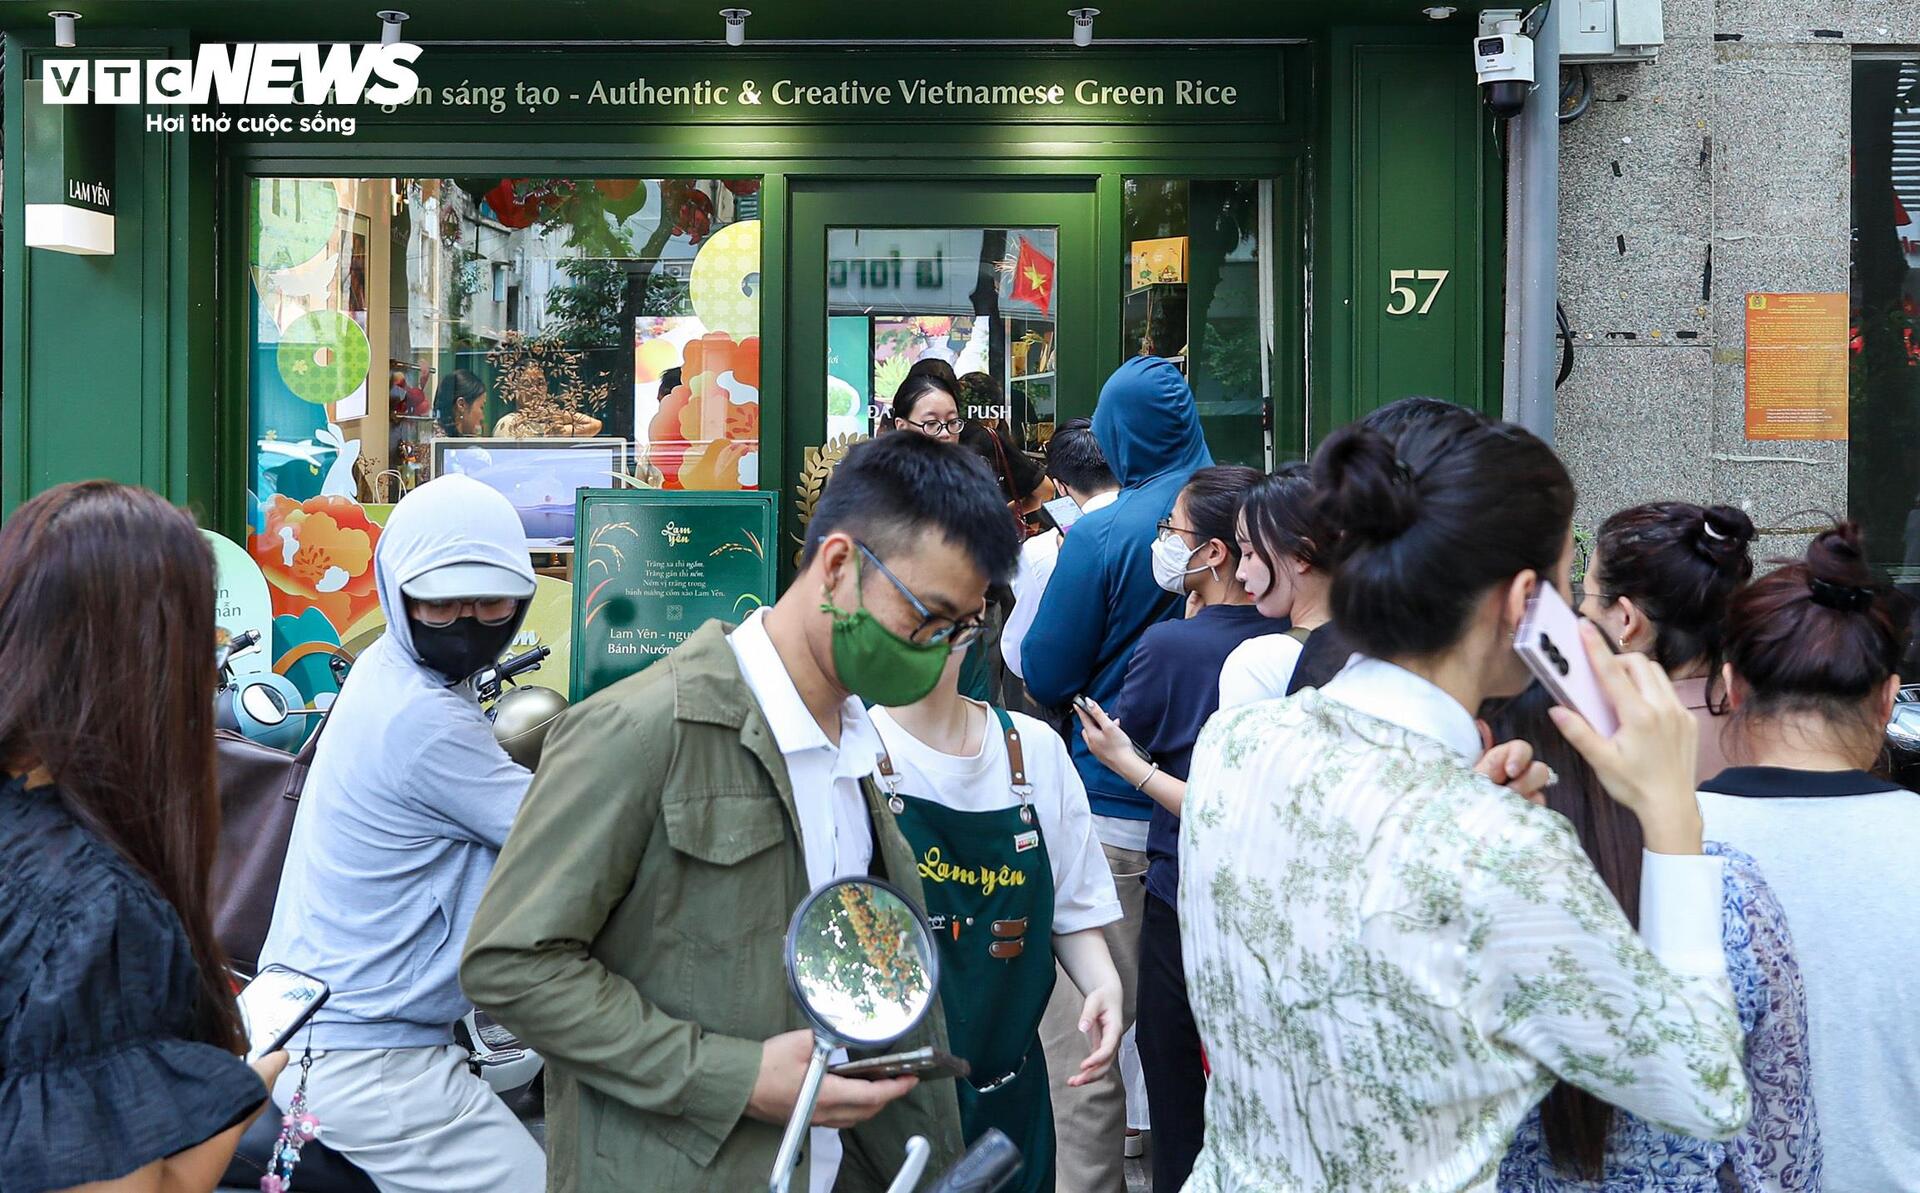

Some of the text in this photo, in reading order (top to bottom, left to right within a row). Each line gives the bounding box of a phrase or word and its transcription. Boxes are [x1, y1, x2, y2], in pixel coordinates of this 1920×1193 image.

[442, 79, 506, 114] sáng
[515, 80, 560, 113] tạo
[587, 78, 728, 105] Authentic
[738, 80, 762, 105] &
[771, 80, 891, 105] Creative
[898, 79, 1064, 105] Vietnamese
[1075, 79, 1164, 105] Green
[1175, 79, 1237, 105] Rice
[69, 179, 110, 207] LAM YÊN
[1386, 269, 1450, 315] 57
[967, 405, 1012, 419] PUSH
[661, 521, 692, 536] Lam
[610, 629, 633, 639] Lam
[637, 628, 658, 639] Yên
[608, 643, 636, 654] Bánh
[917, 847, 978, 885] Lam
